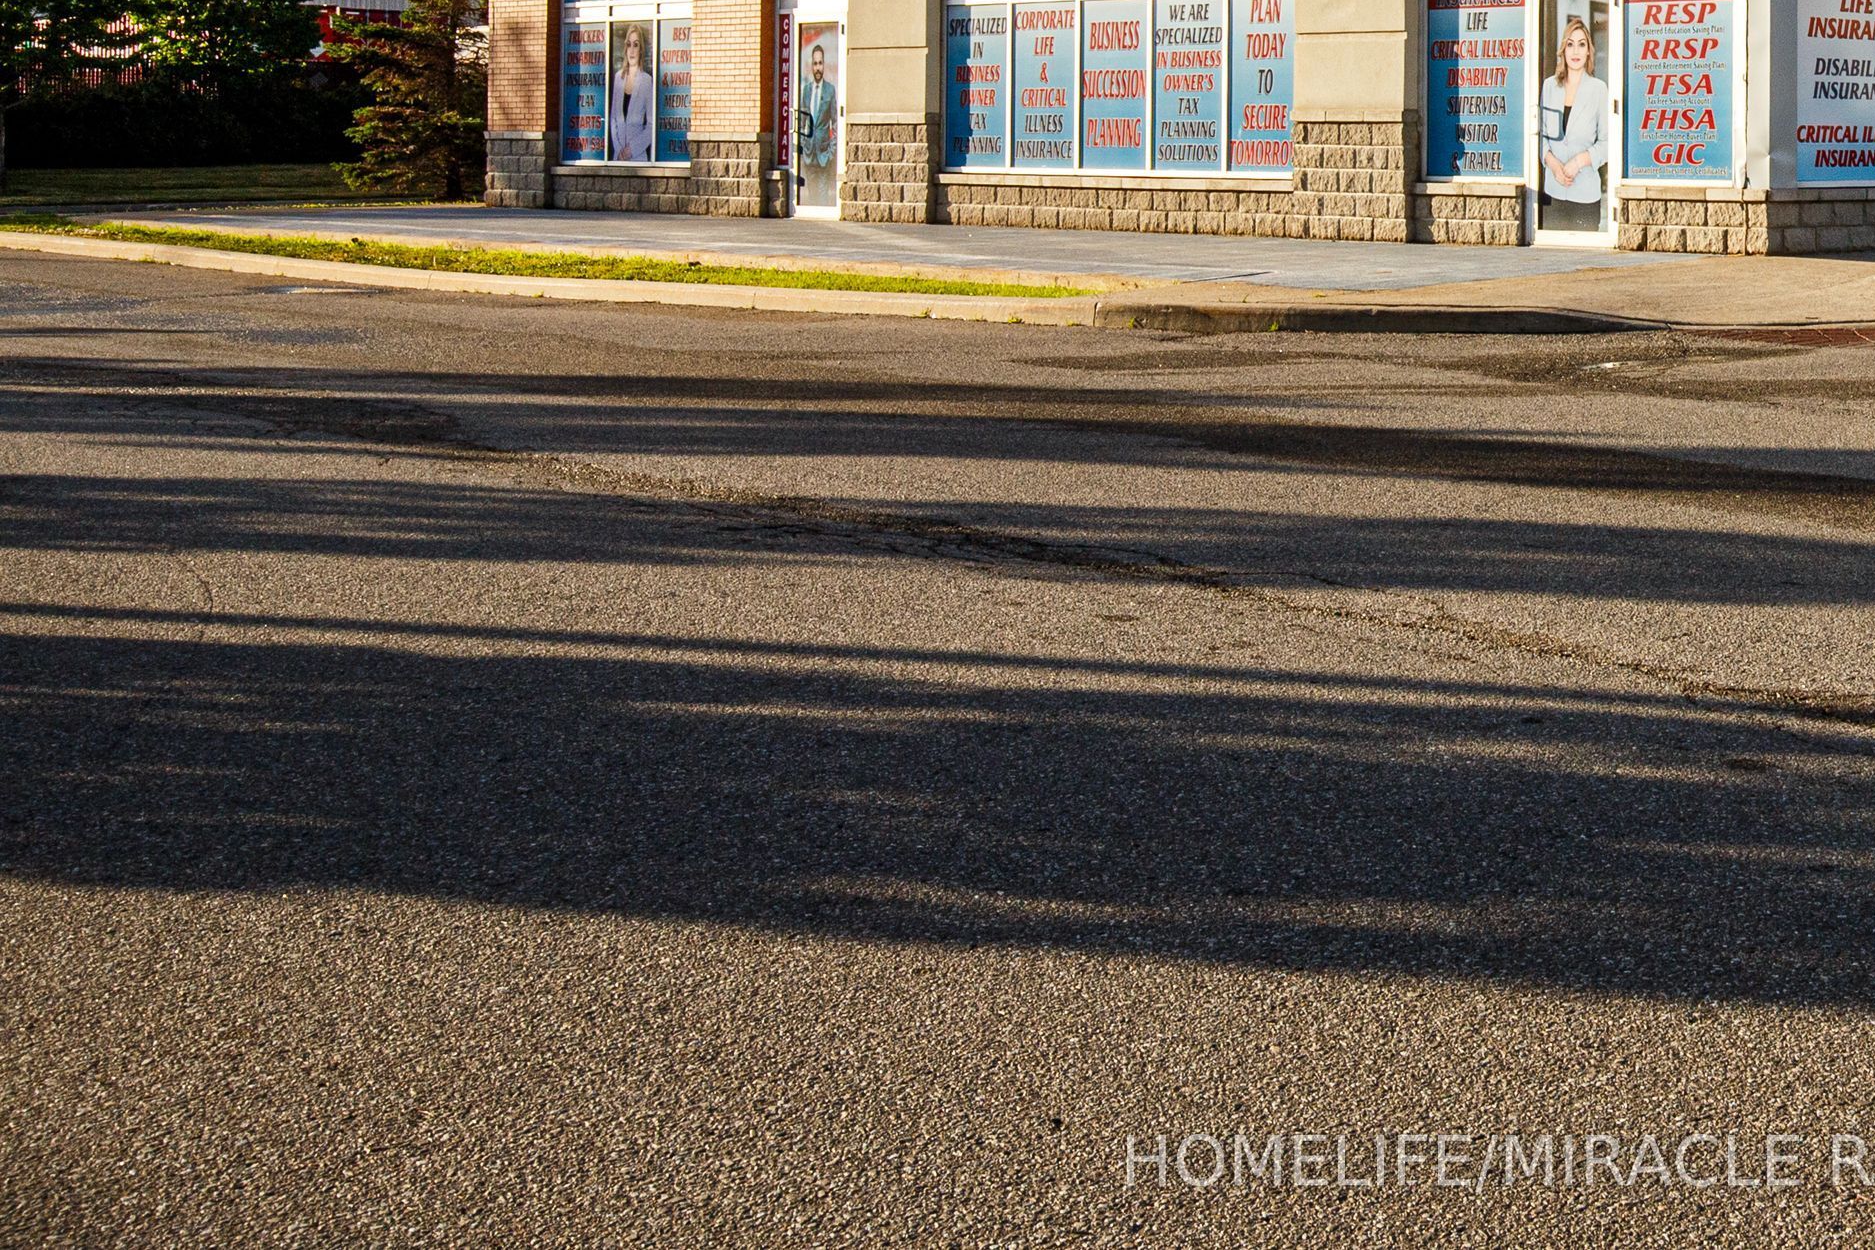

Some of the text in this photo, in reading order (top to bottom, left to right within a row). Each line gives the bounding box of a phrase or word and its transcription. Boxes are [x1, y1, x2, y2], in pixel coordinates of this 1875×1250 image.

[1015, 9, 1075, 31] CORPORATE
[1169, 3, 1210, 22] WE ARE
[1467, 11, 1489, 31] LIFE
[1643, 2, 1717, 25] RESP
[568, 29, 605, 44] TRUCKERS
[1089, 20, 1140, 51] BUSINESS
[1156, 26, 1223, 46] SPECIALIZED
[1034, 36, 1055, 56] LIFE
[1246, 33, 1287, 60] TODAY
[1431, 38, 1525, 61] CRITICAL ILLNESS
[1641, 38, 1719, 60] RRSP
[1157, 50, 1222, 69] IN BUSINESS
[956, 64, 1001, 83] BUSINESS
[1040, 62, 1048, 83] &
[1164, 73, 1214, 92] OWNER'S
[1258, 69, 1274, 95] TO
[1447, 67, 1508, 87] DISABILITY
[781, 18, 790, 161] COMMERCIAL
[1083, 69, 1146, 99] SUCCESSION
[1645, 73, 1713, 95] TFSA
[960, 88, 996, 107] OWNER
[1021, 88, 1067, 108] CRITICAL
[1178, 97, 1199, 116] TAX
[1447, 95, 1507, 115] SUPERVISA
[1025, 114, 1064, 133] ILLNESS
[1243, 104, 1288, 130] SECURE
[1641, 108, 1716, 130] FHSA
[1086, 117, 1141, 149] PLANNING
[1161, 120, 1216, 139] PLANNING
[1796, 124, 1859, 144] CRITICAL
[1016, 140, 1073, 159] INSURANCE
[1158, 144, 1219, 162] SOLUTIONS
[1653, 143, 1705, 165] GIC
[1451, 151, 1503, 171] & TRAVEL
